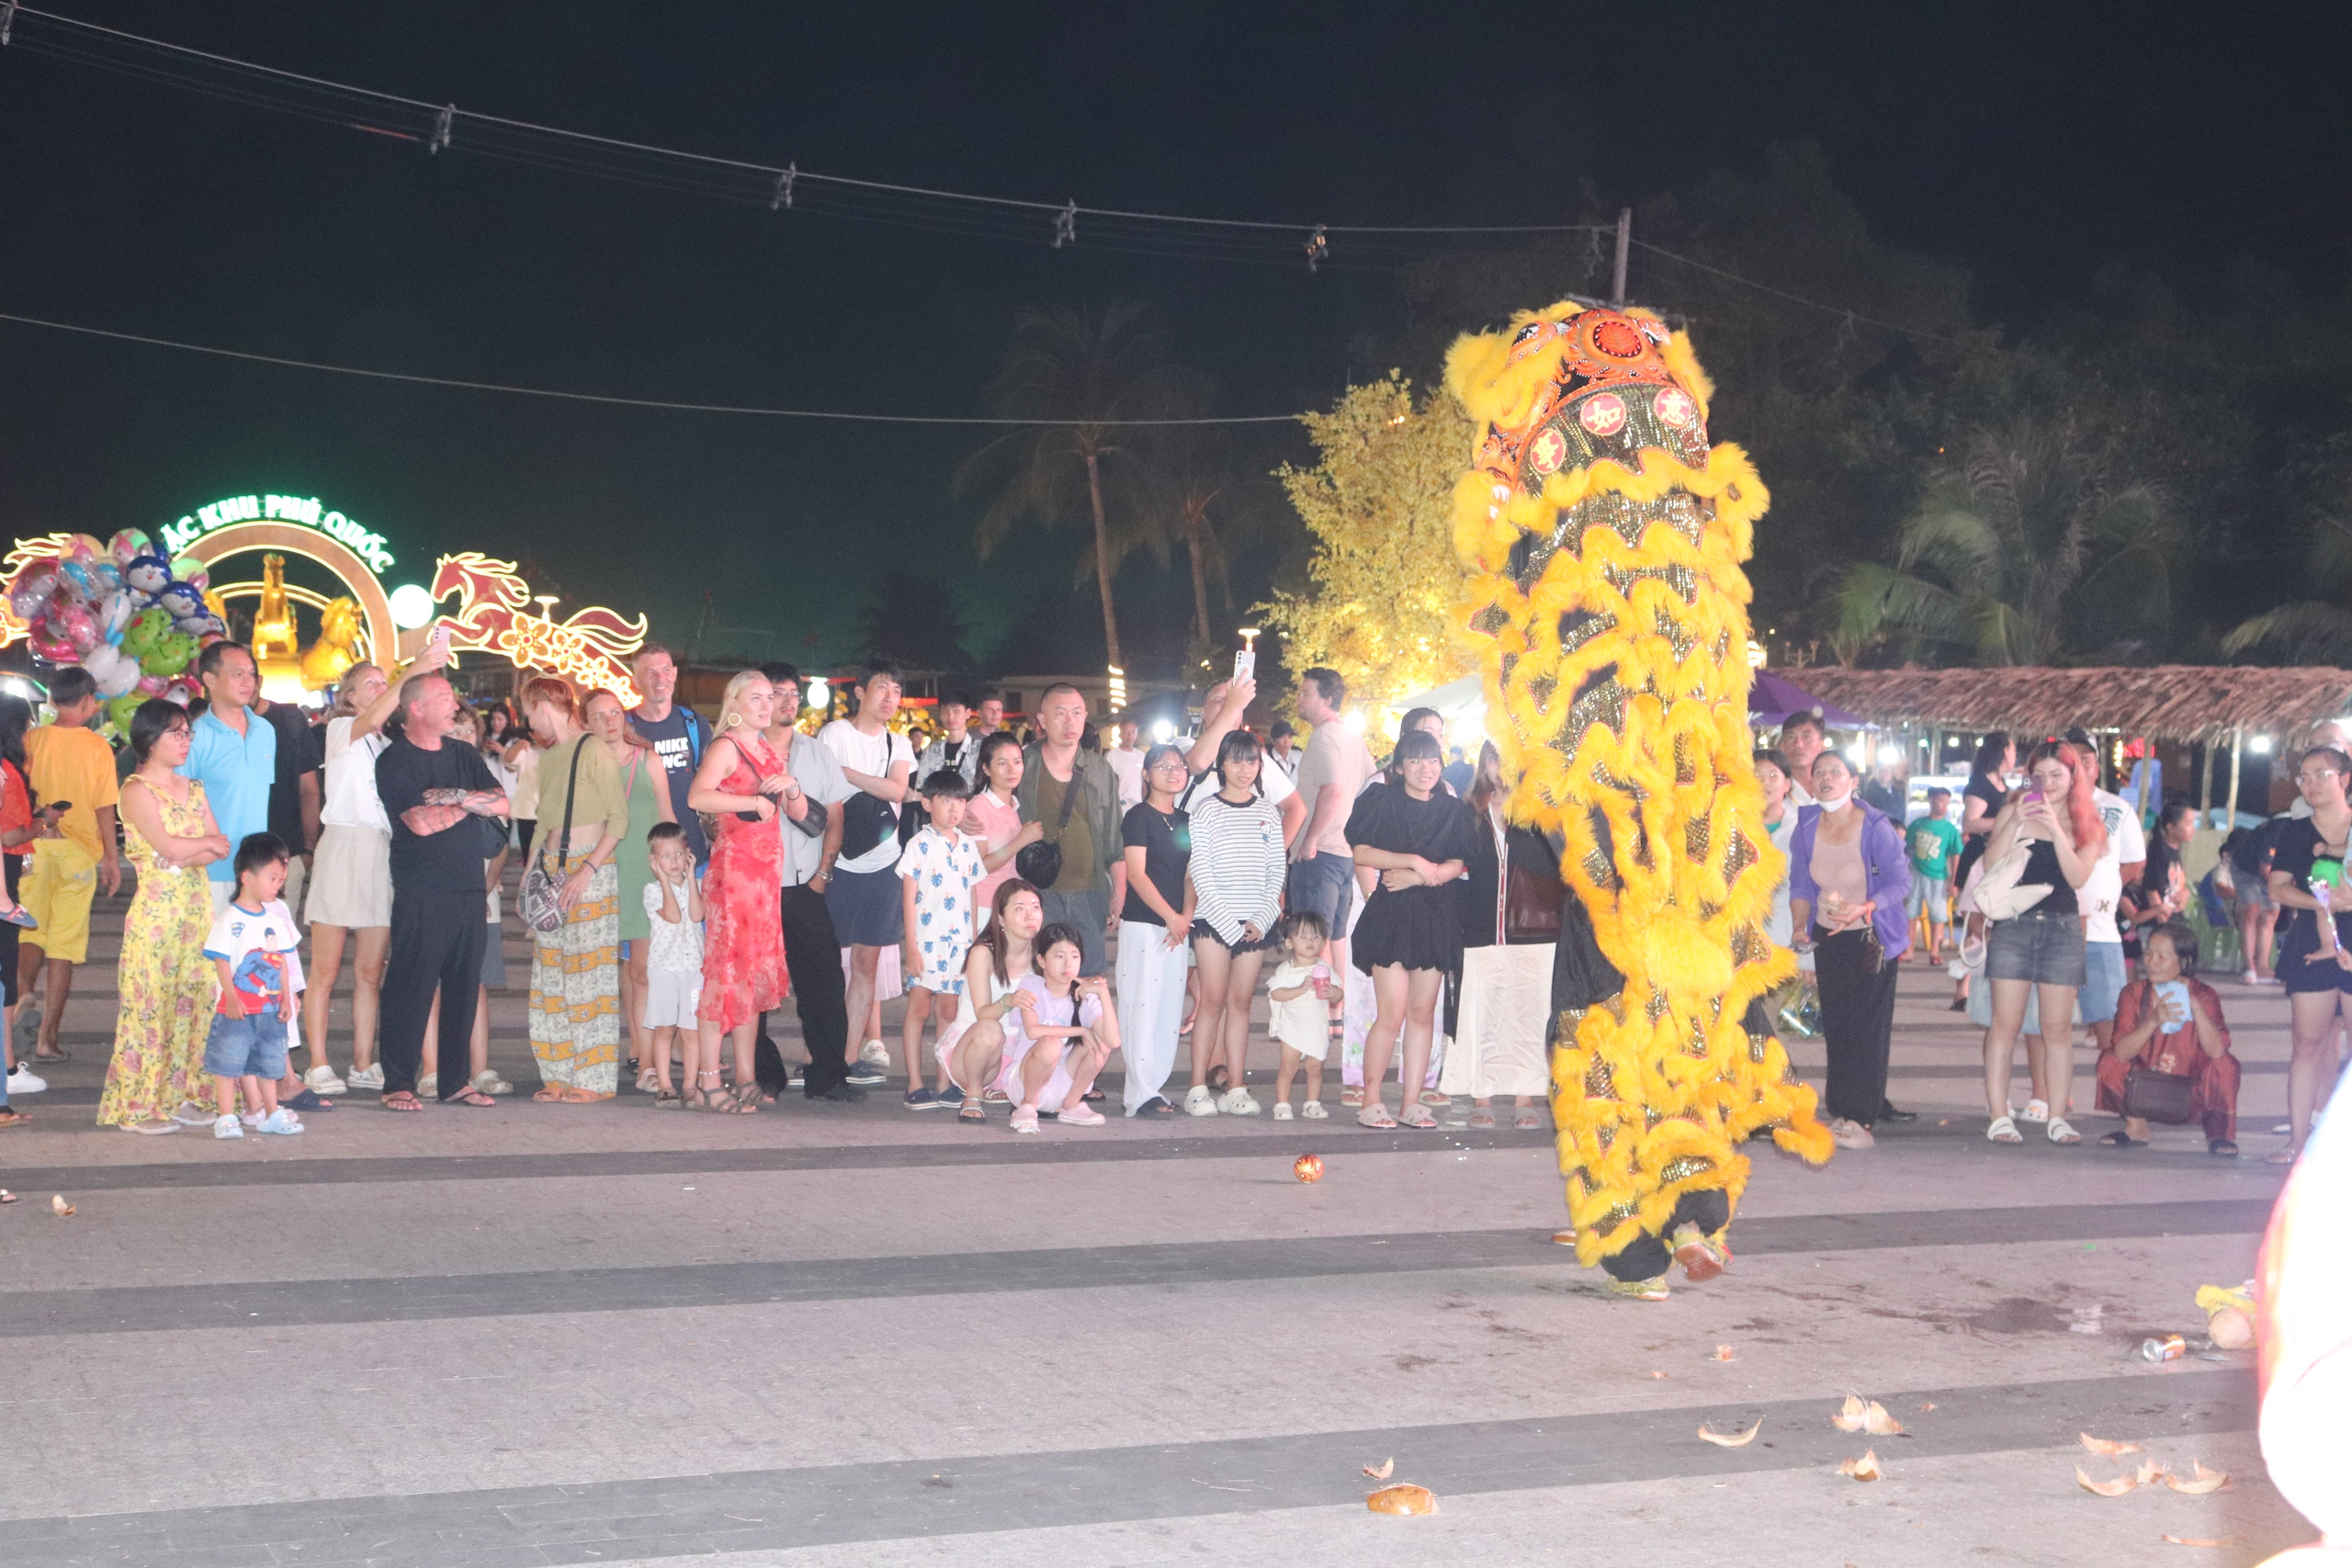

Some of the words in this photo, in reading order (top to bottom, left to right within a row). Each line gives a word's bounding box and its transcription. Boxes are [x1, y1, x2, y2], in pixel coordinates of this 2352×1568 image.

[1586, 400, 1621, 430] 如
[1660, 389, 1688, 425] 意
[1532, 432, 1559, 469] 事
[160, 514, 201, 553] ẶC
[198, 495, 260, 530] KHU
[265, 494, 322, 525] PHÚ
[323, 512, 394, 573] QUỐC
[654, 737, 688, 753] NIKE
[662, 753, 687, 769] NC.
